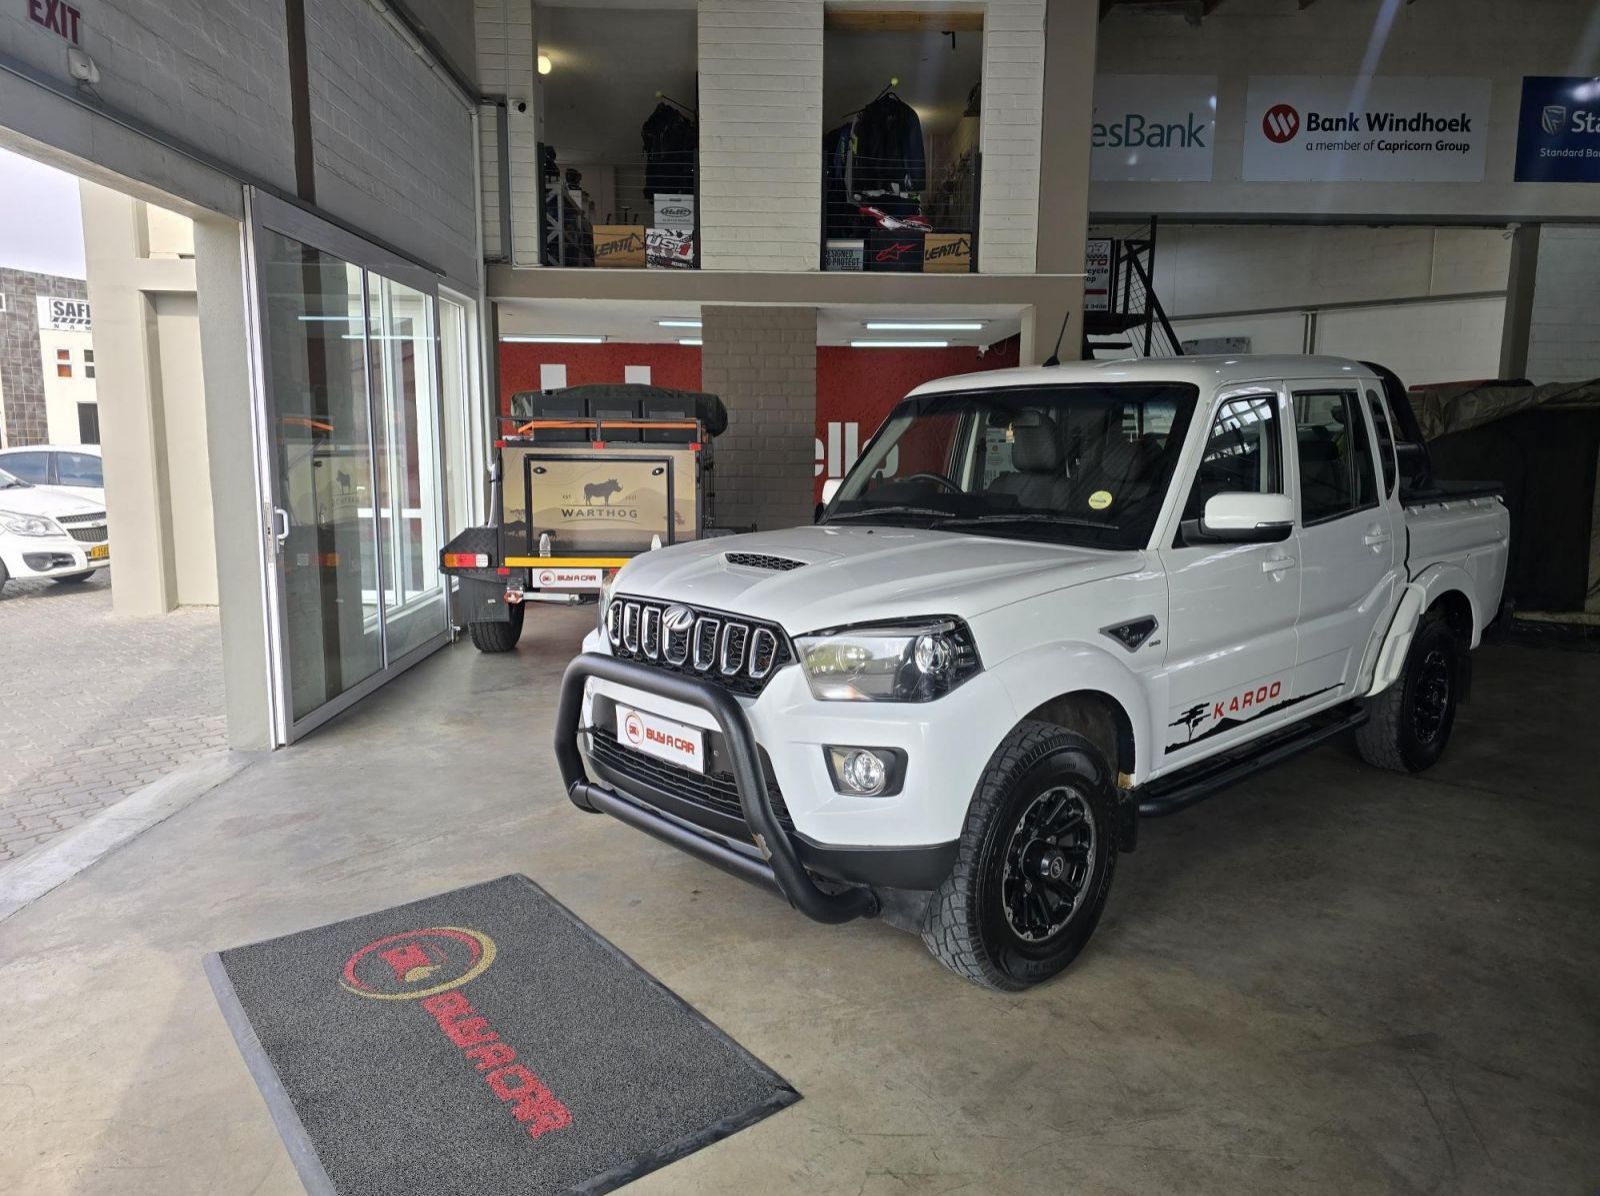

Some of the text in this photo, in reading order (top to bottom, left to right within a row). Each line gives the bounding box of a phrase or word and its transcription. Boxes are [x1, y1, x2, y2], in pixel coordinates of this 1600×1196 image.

[29, 0, 81, 46] EXIT
[1306, 112, 1472, 132] Bank Windhoek
[1305, 139, 1471, 154] a member of Capricorn Group
[1540, 147, 1584, 157] Standard
[561, 508, 638, 519] WARTHOG
[1213, 681, 1281, 720] KAROO
[646, 727, 696, 755] BUY A CAR
[421, 991, 574, 1141] BUY A CAR
